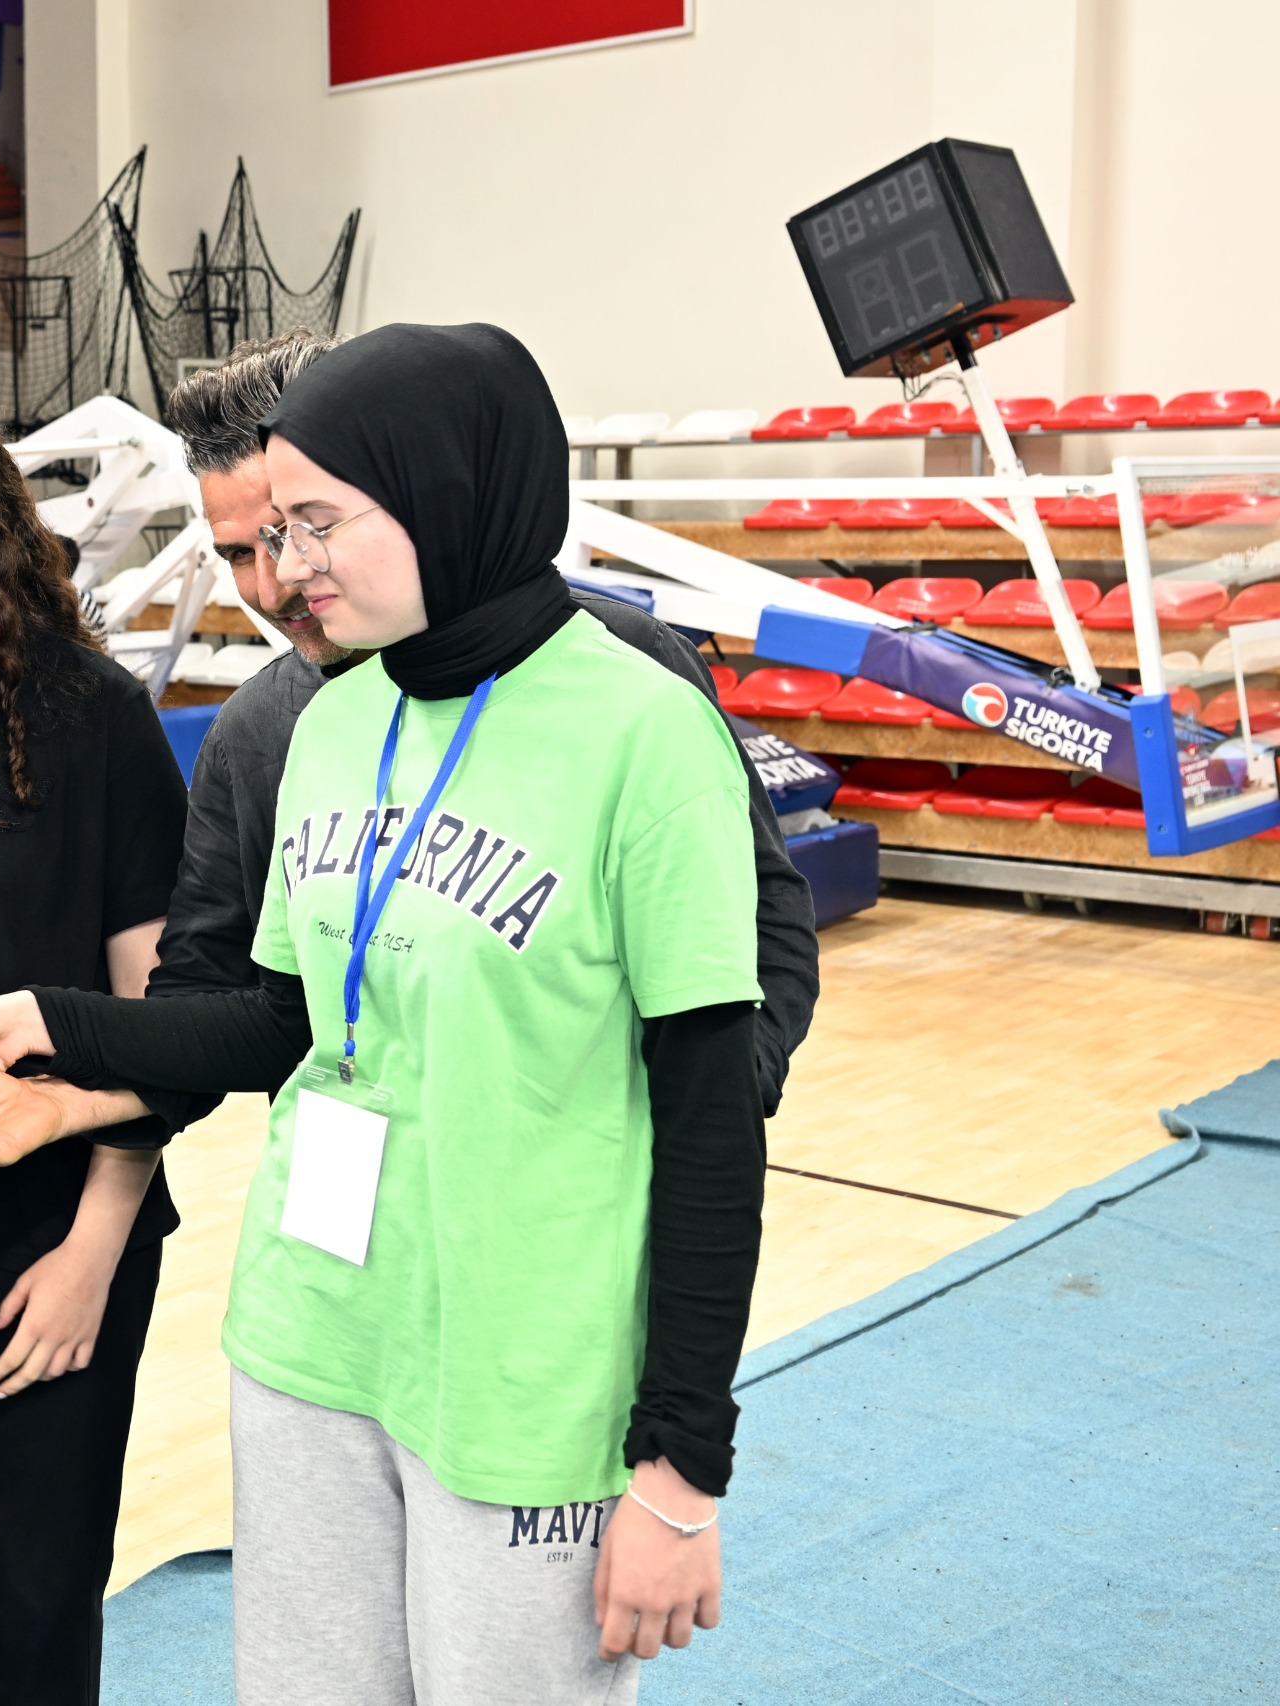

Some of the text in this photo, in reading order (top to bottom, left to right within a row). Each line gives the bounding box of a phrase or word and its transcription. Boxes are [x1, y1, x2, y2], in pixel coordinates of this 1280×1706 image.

[754, 756, 827, 786] ORTA
[319, 922, 346, 940] West
[384, 933, 415, 953] USA
[547, 1551, 561, 1563] EST
